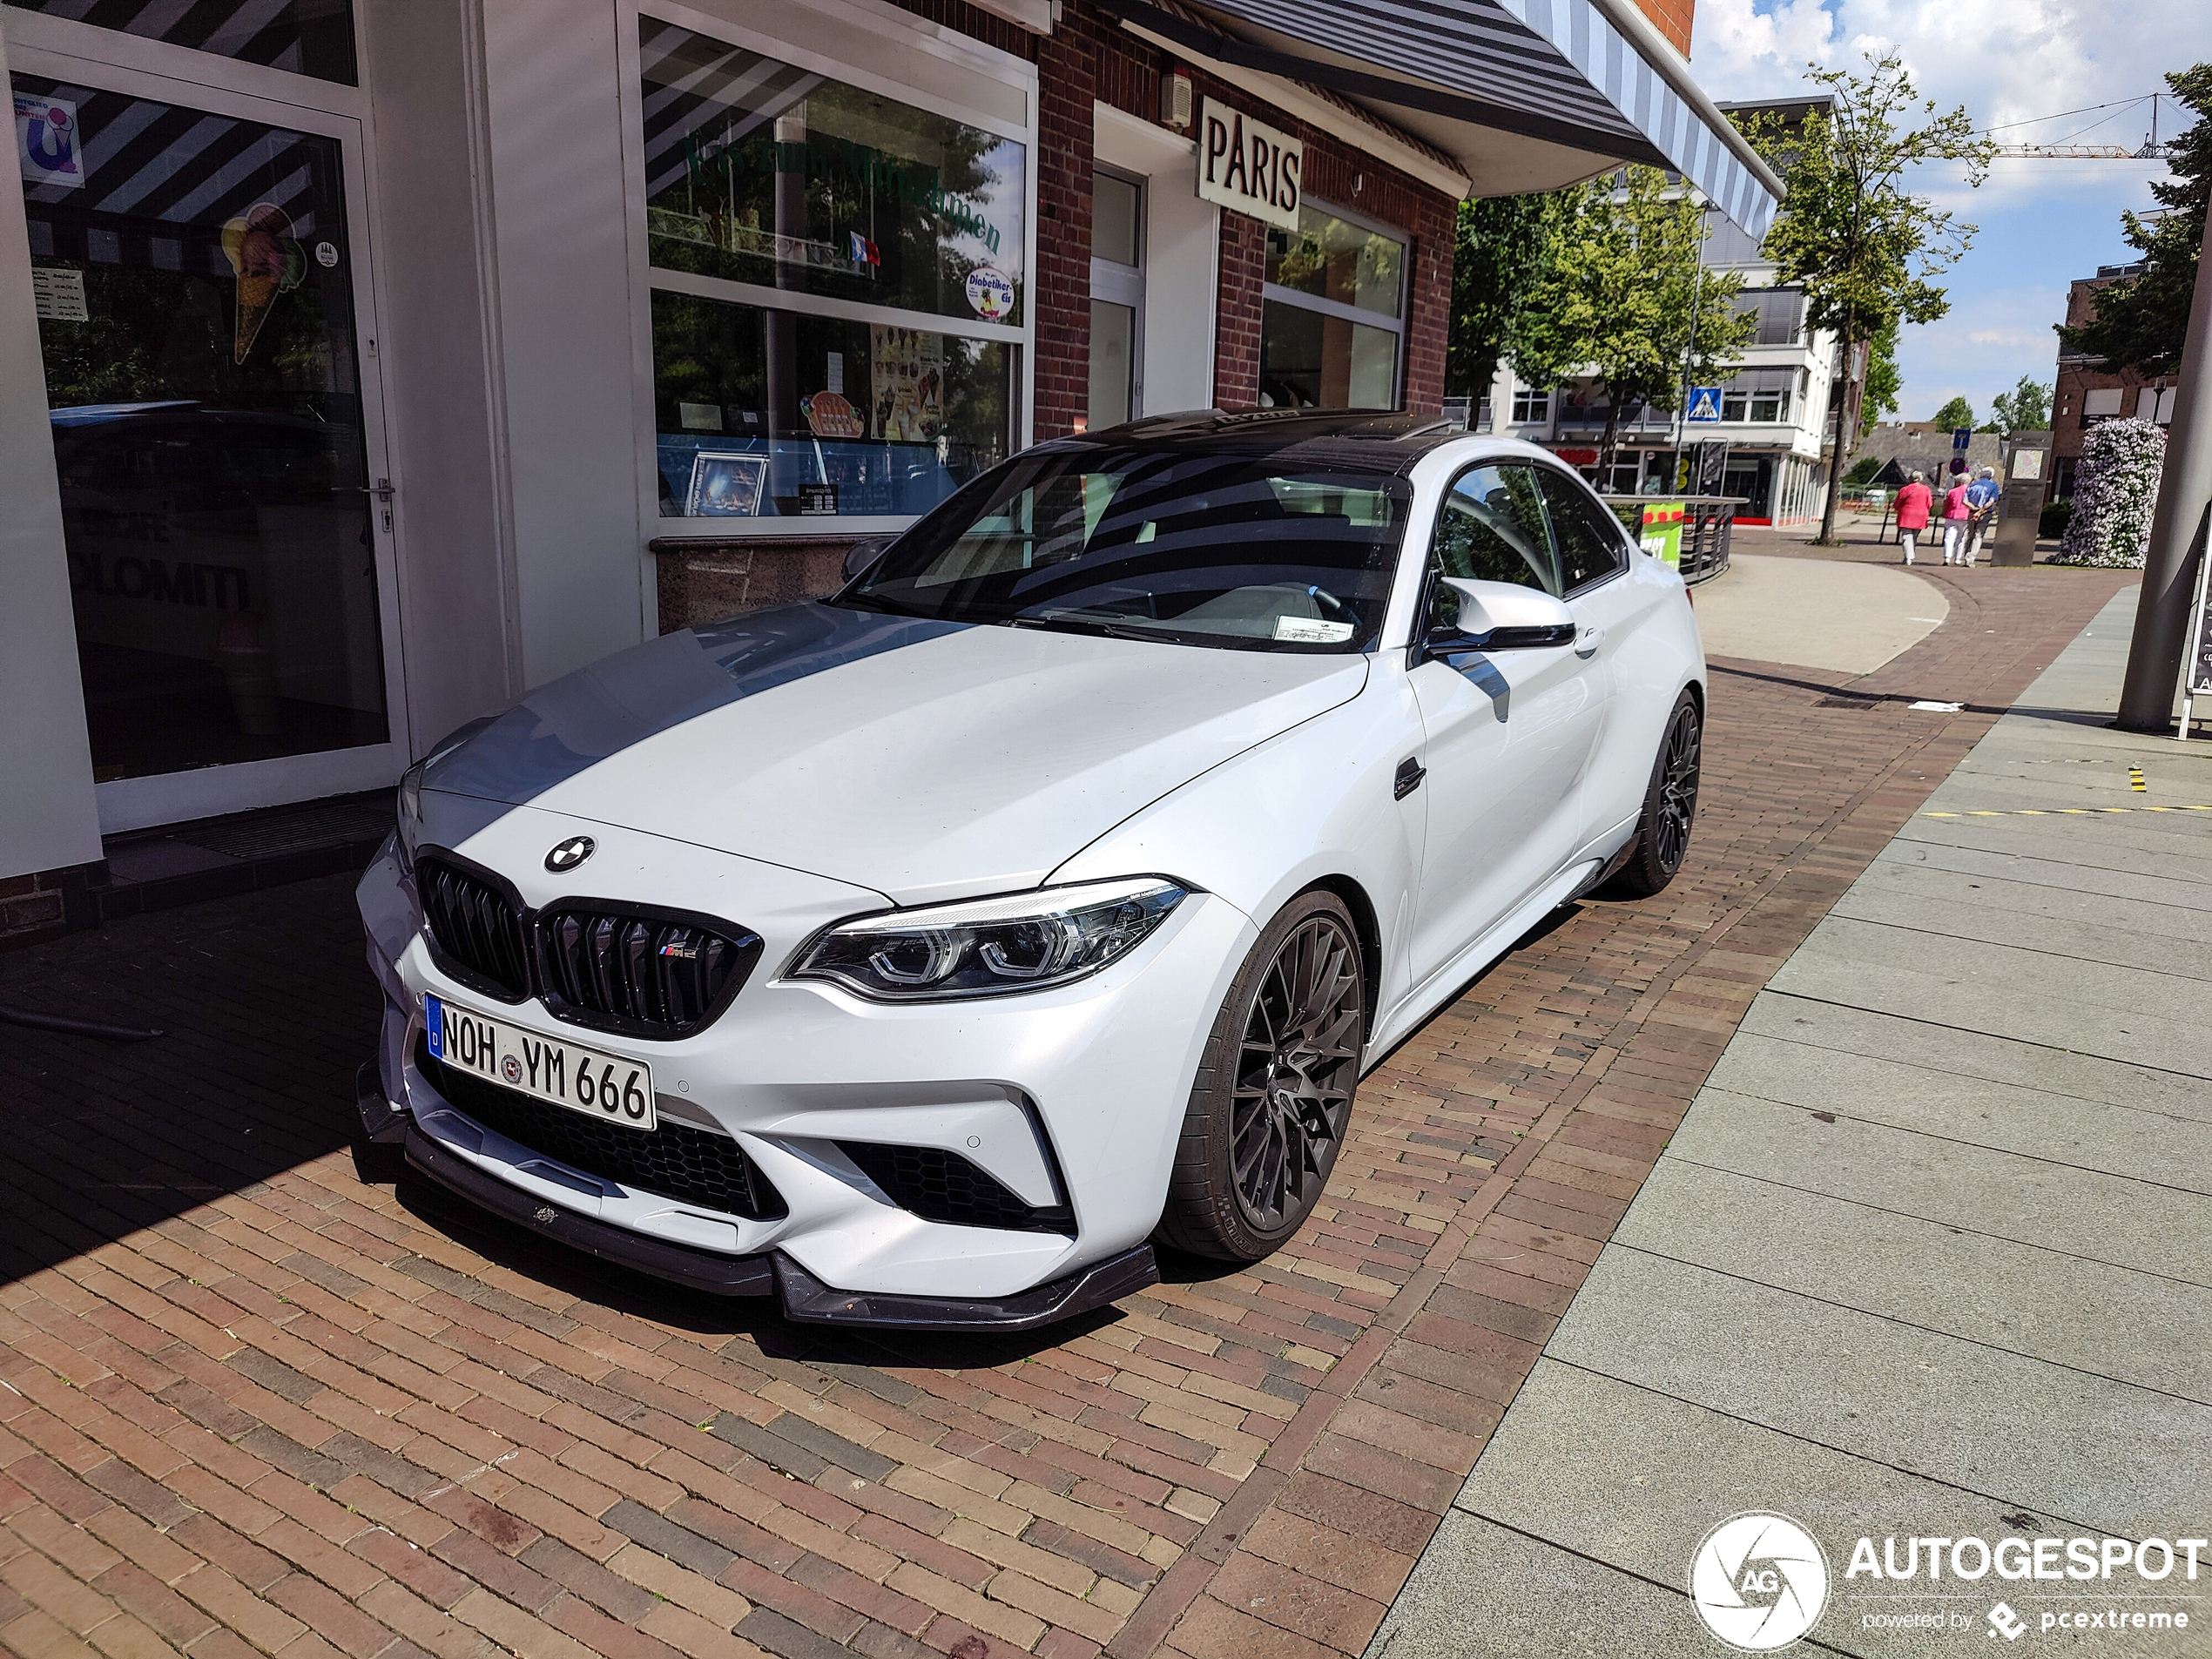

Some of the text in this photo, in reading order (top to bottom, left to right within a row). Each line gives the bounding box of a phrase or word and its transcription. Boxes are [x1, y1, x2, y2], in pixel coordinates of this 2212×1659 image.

[1206, 113, 1298, 212] PARIS
[969, 274, 1012, 292] Diabetiker-
[1001, 293, 1011, 303] Eis
[671, 947, 696, 960] M2
[432, 1031, 439, 1046] D
[442, 1007, 646, 1120] NOH YM 666
